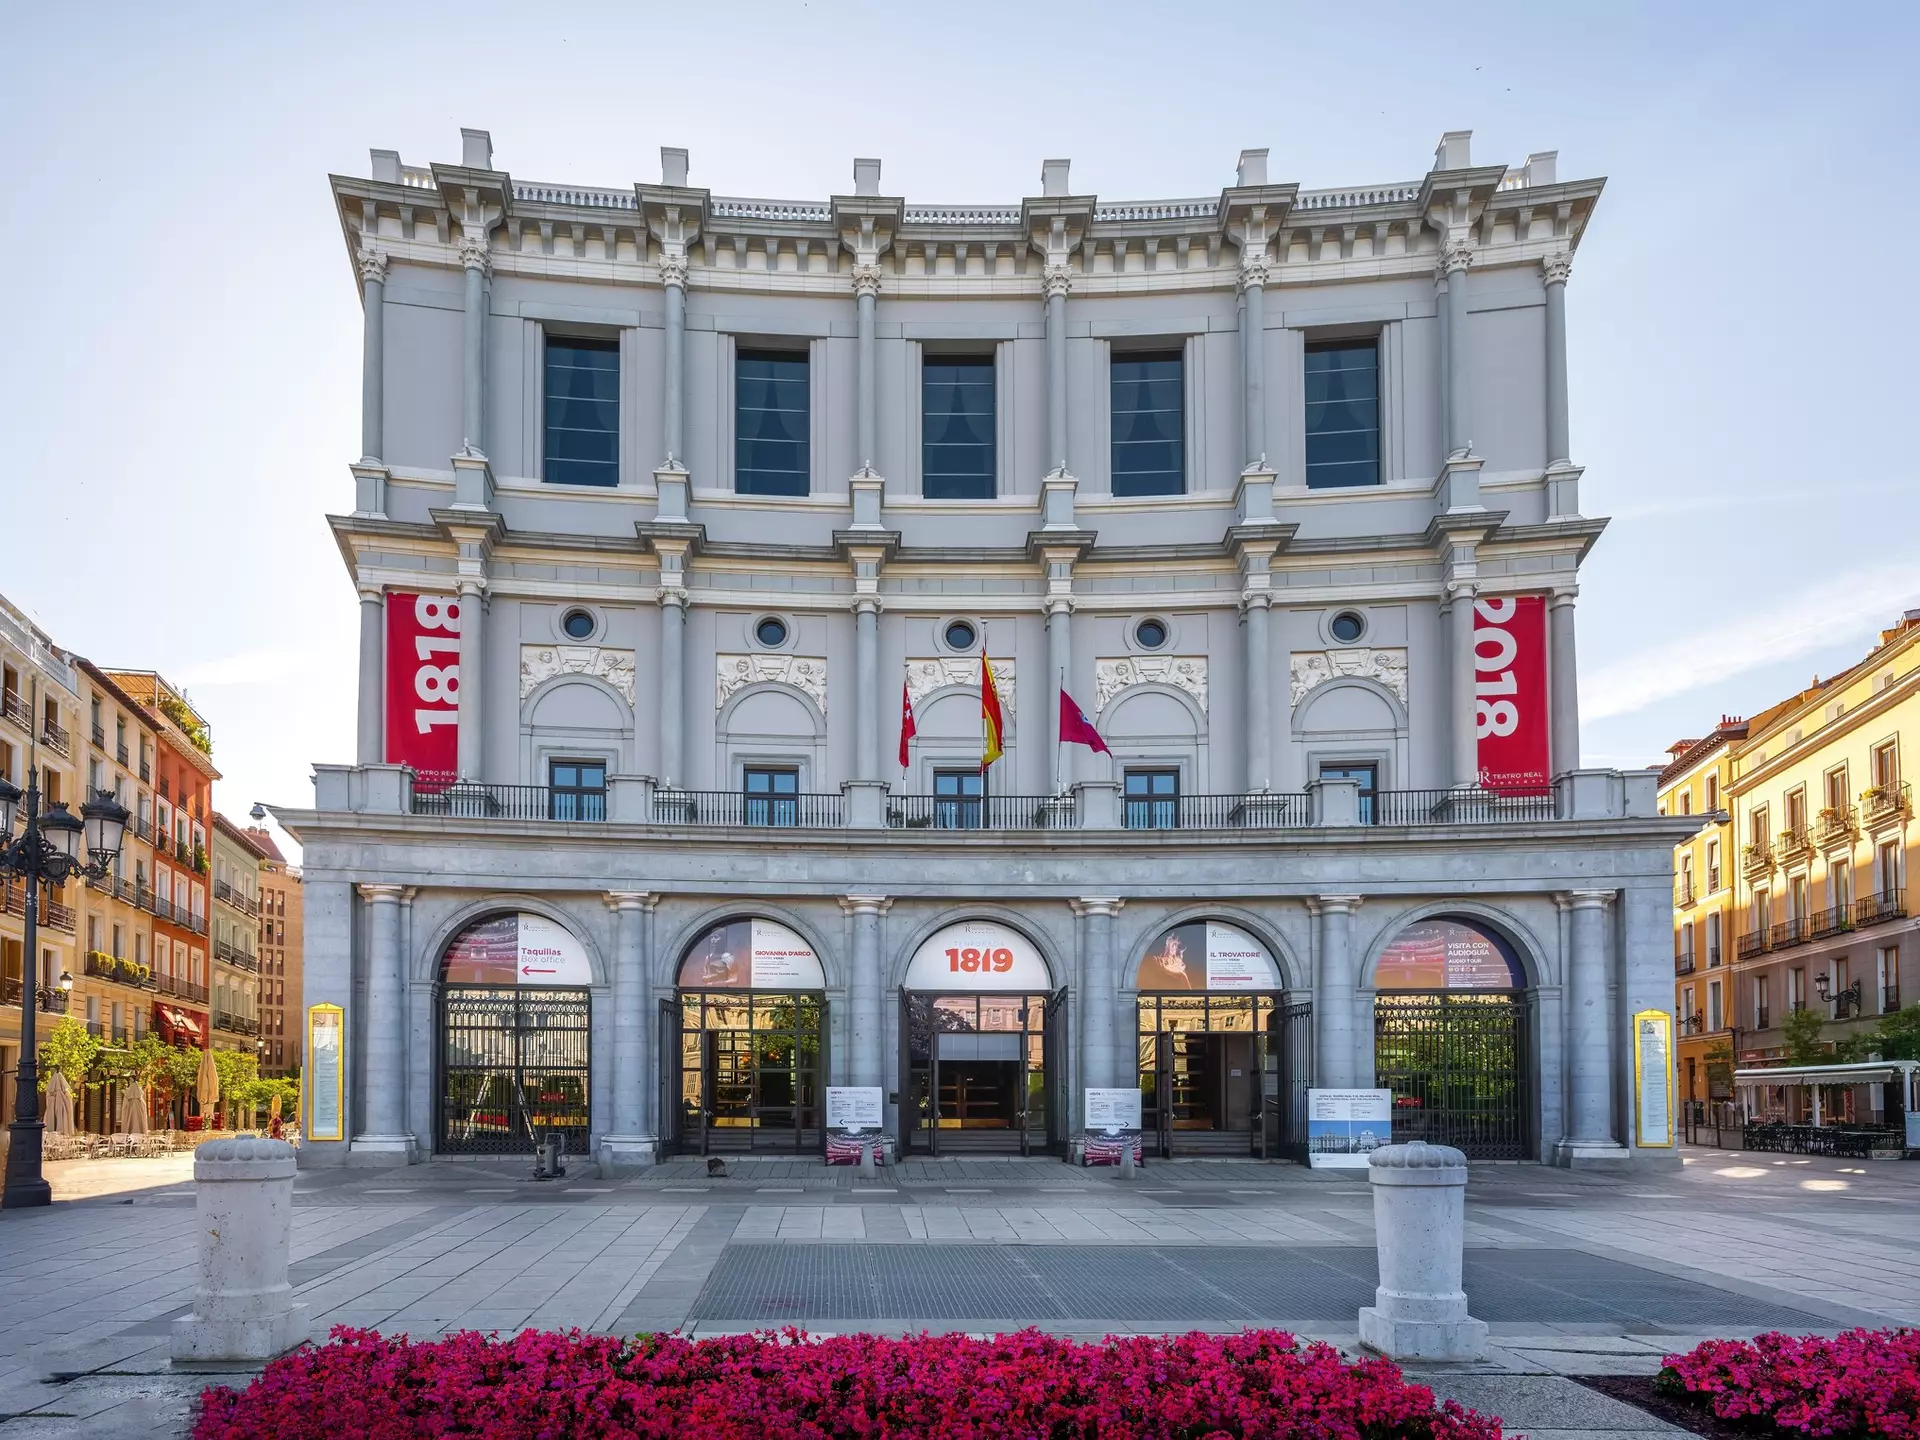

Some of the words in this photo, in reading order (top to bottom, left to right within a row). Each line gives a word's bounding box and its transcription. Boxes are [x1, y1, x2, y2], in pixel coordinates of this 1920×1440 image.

[415, 594, 460, 735] 1818
[1473, 597, 1519, 740] 2018
[521, 947, 562, 957] Taquillas
[521, 955, 538, 963] Box
[540, 955, 566, 964] office
[945, 948, 1014, 973] 1819
